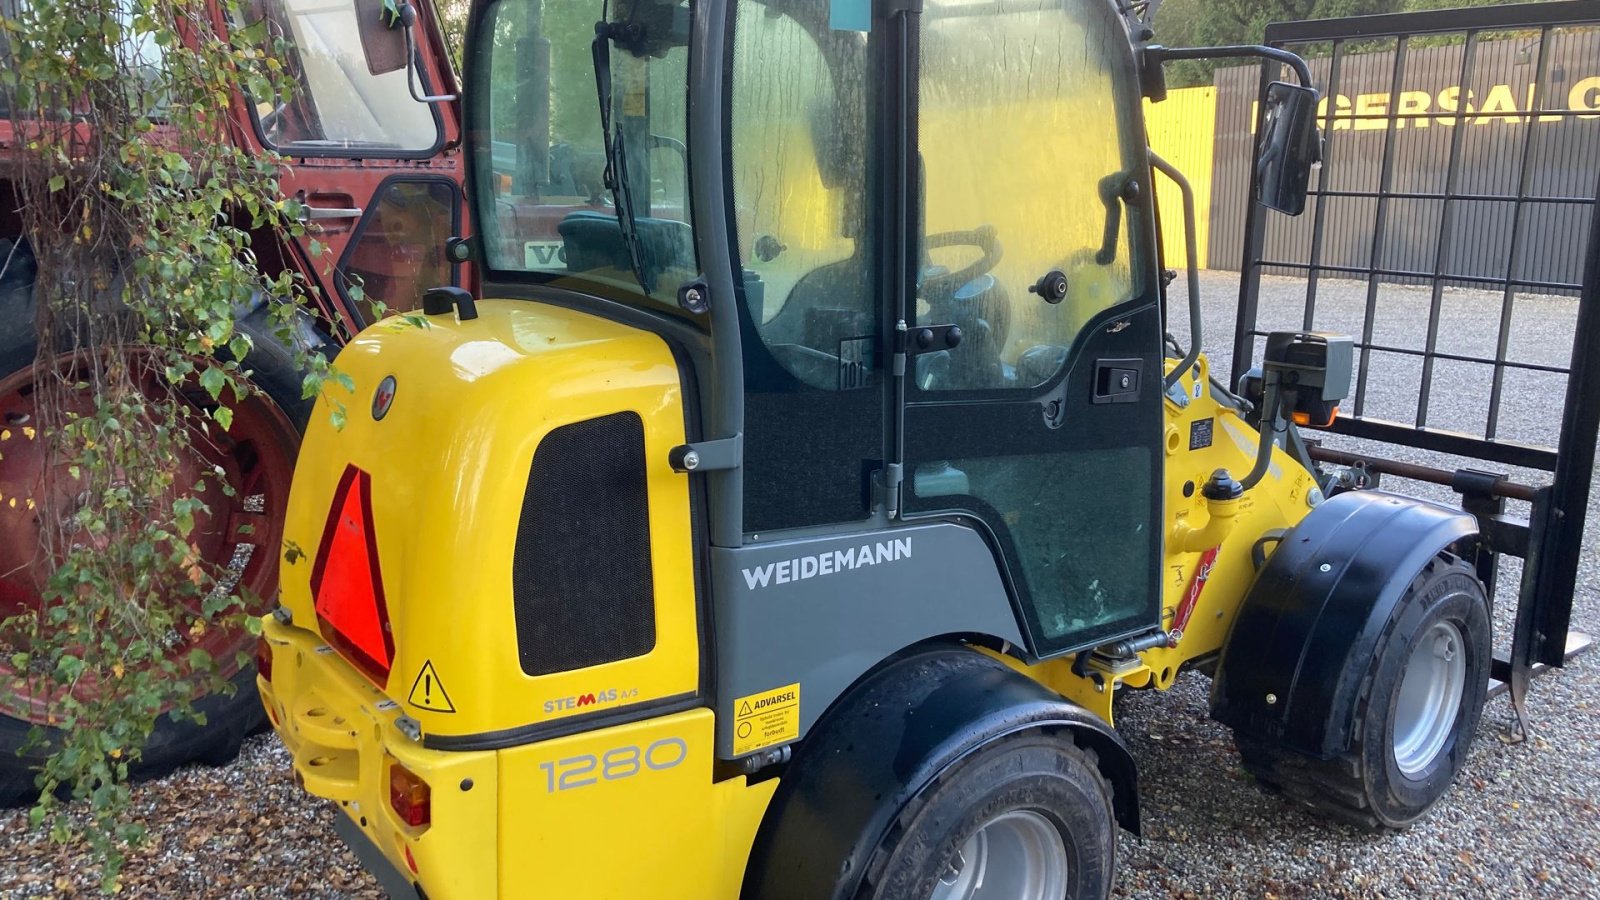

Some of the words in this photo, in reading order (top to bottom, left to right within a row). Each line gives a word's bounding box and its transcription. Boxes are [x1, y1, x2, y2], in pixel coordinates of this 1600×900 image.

[742, 537, 912, 590] WEIDEMANN
[543, 689, 618, 713] STEMAS
[621, 688, 638, 699] A/S
[754, 691, 796, 710] ADVARSEL
[539, 737, 688, 794] 1280
